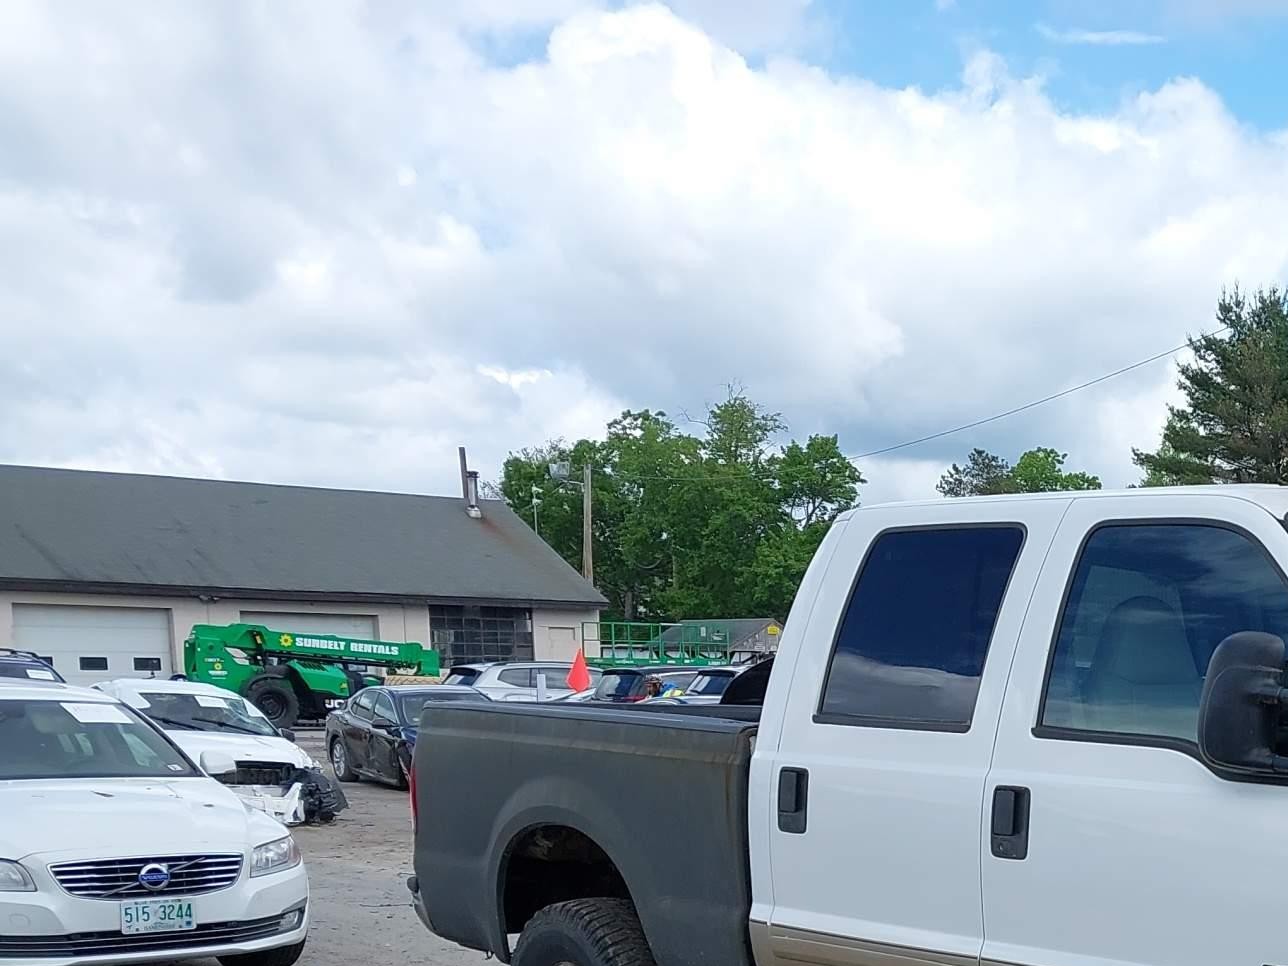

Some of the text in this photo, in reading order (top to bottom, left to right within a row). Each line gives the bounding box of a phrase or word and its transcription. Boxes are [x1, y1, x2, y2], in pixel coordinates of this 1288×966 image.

[295, 637, 399, 655] SUNBELT RENTALS
[325, 699, 347, 709] JC
[124, 903, 193, 924] 515 3244
